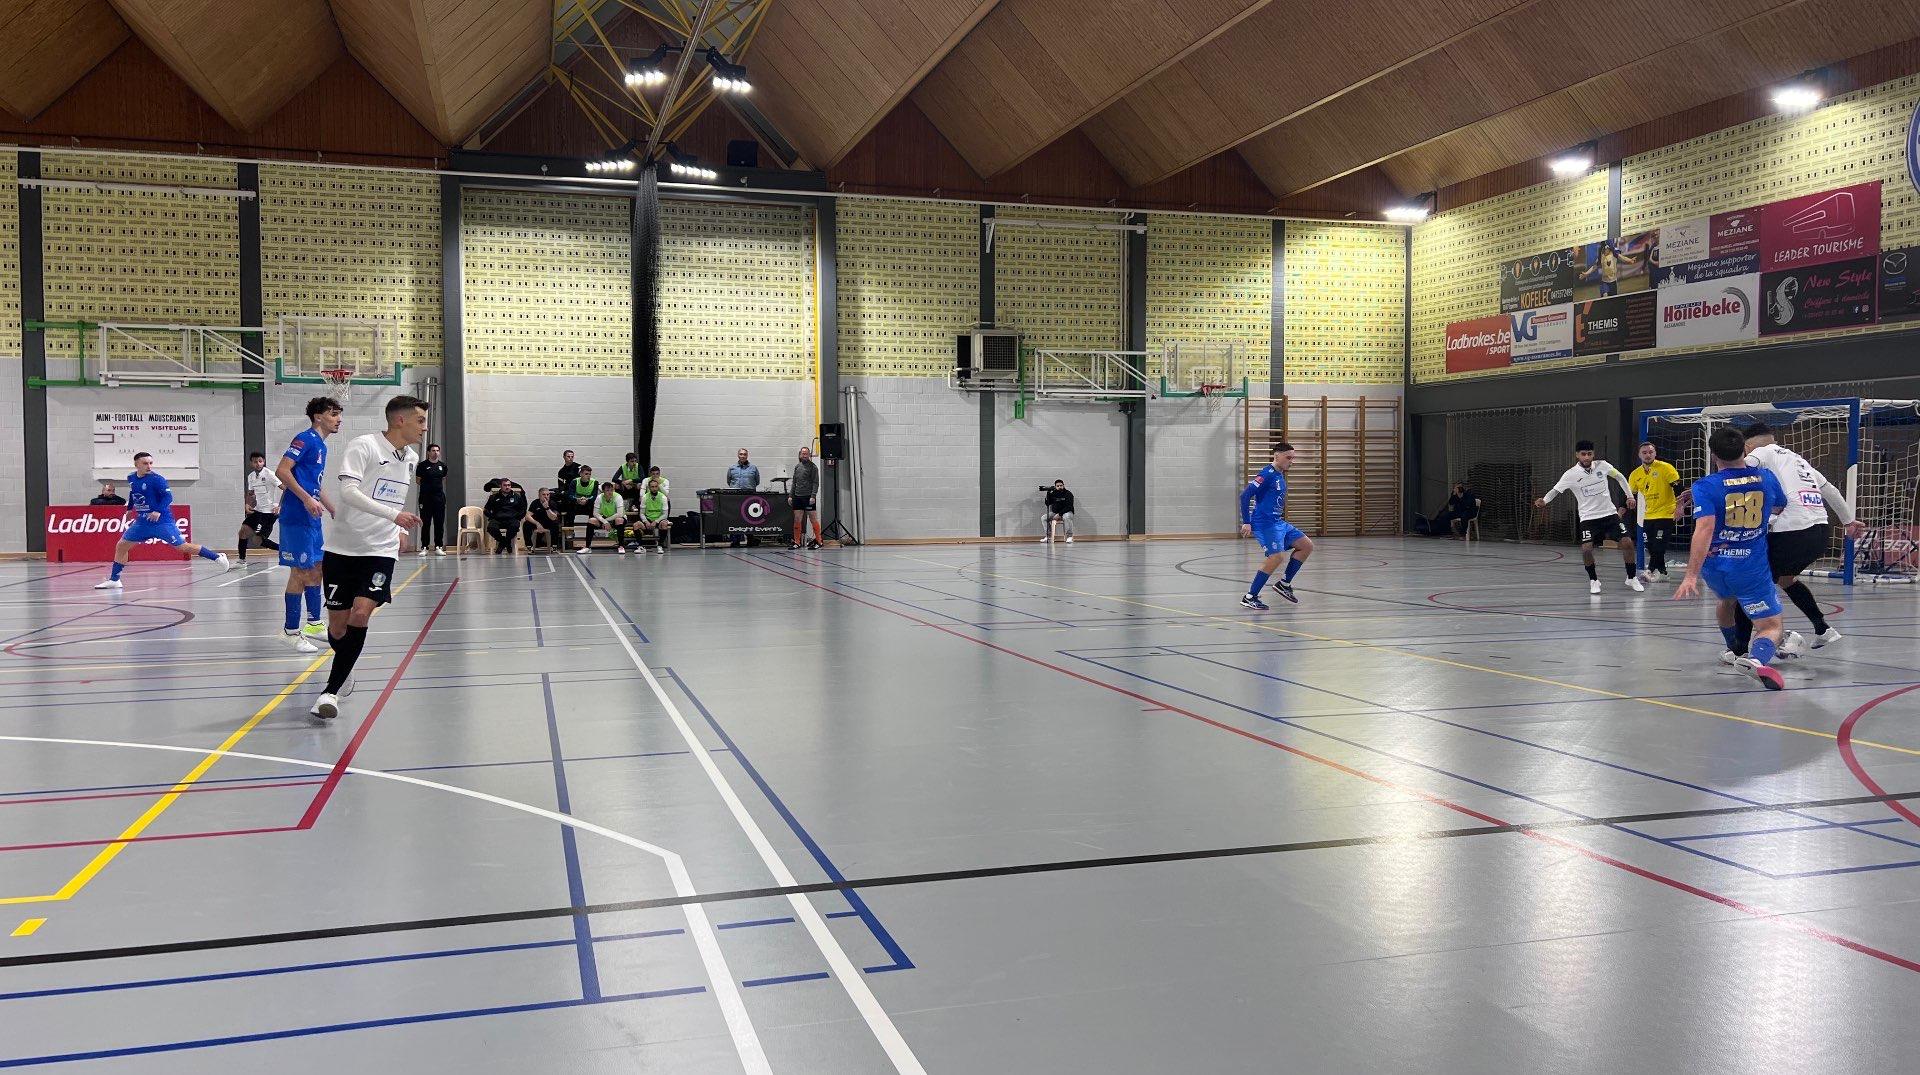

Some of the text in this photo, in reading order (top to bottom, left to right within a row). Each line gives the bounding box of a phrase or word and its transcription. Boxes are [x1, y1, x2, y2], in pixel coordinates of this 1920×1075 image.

[1717, 225, 1754, 237] MEZIANE
[1665, 237, 1700, 250] MEZIANE
[1774, 237, 1864, 263] LEADER TOURISME
[1687, 253, 1757, 271] Meziane supporter
[1693, 270, 1704, 280] de
[1705, 269, 1714, 278] la
[1802, 274, 1831, 292] New
[1834, 268, 1873, 289] Style
[1520, 288, 1552, 309] KOFELEC
[1511, 311, 1537, 342] VG
[1588, 318, 1618, 331] THEMIS
[1446, 329, 1511, 351] Ladbrokes.be
[148, 414, 196, 423] MOUSCRONNOIS
[1582, 530, 1592, 539] 15
[1718, 548, 1752, 558] THEMIS
[328, 583, 339, 600] 7
